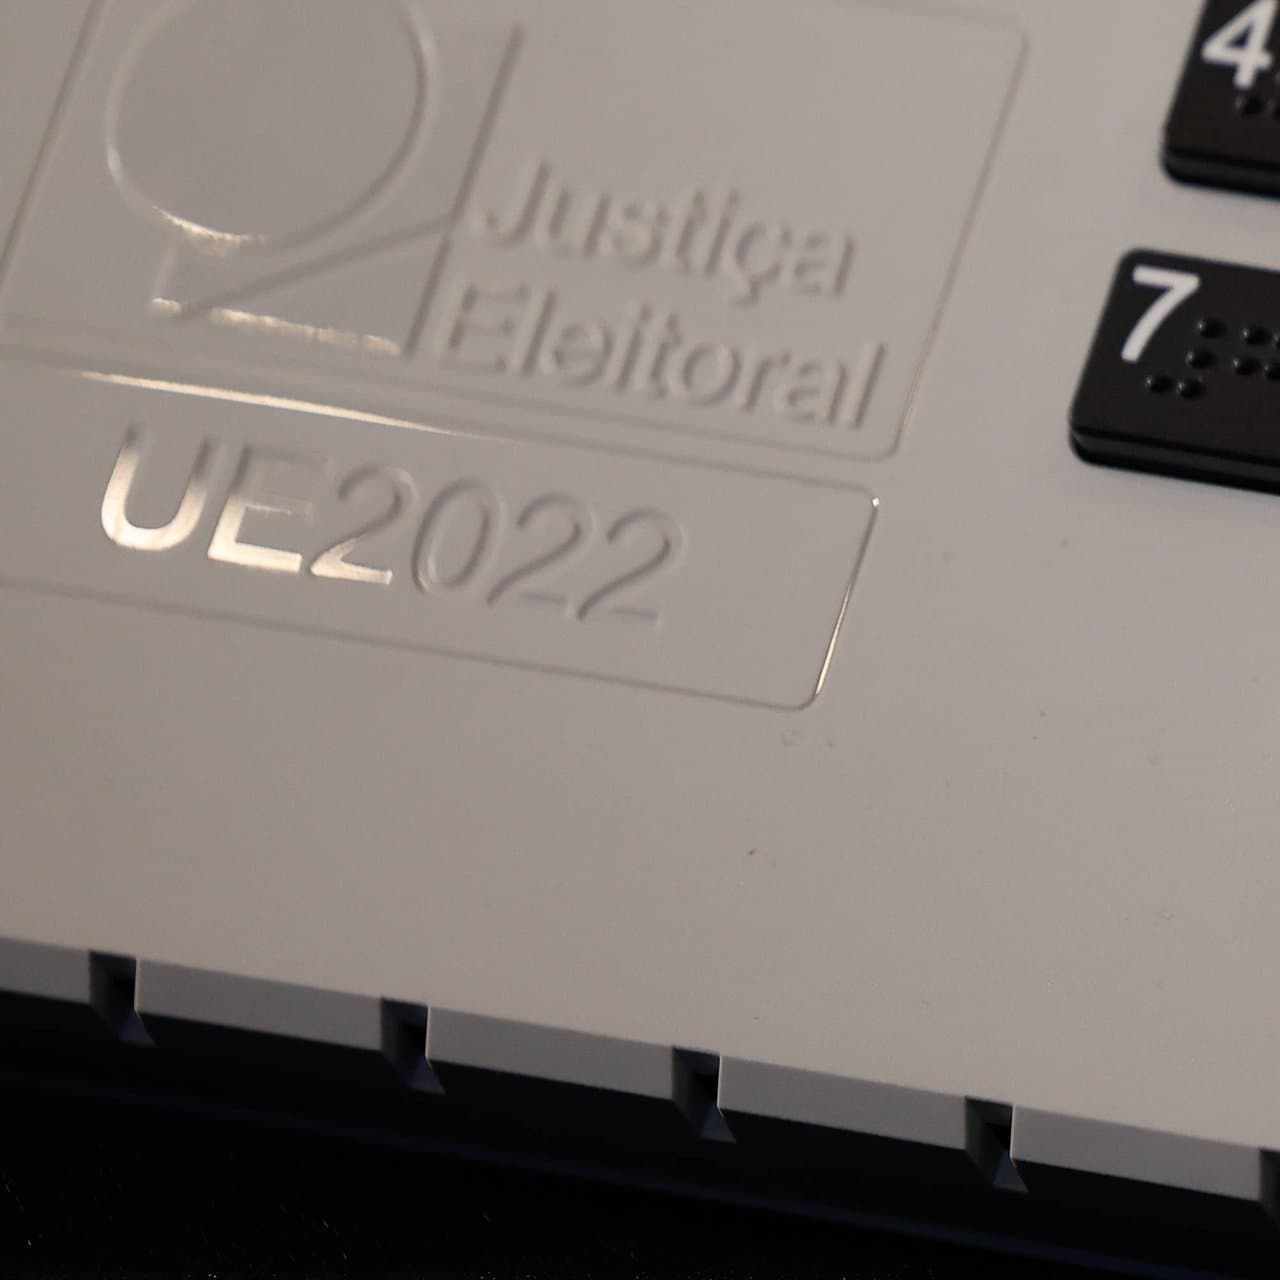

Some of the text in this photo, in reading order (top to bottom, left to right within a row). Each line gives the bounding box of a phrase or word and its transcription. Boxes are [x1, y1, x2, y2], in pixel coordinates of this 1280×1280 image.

[472, 160, 857, 305] Justiça
[435, 282, 890, 429] Eleitoral
[1122, 266, 1199, 361] 7
[100, 423, 687, 626] UE2022
